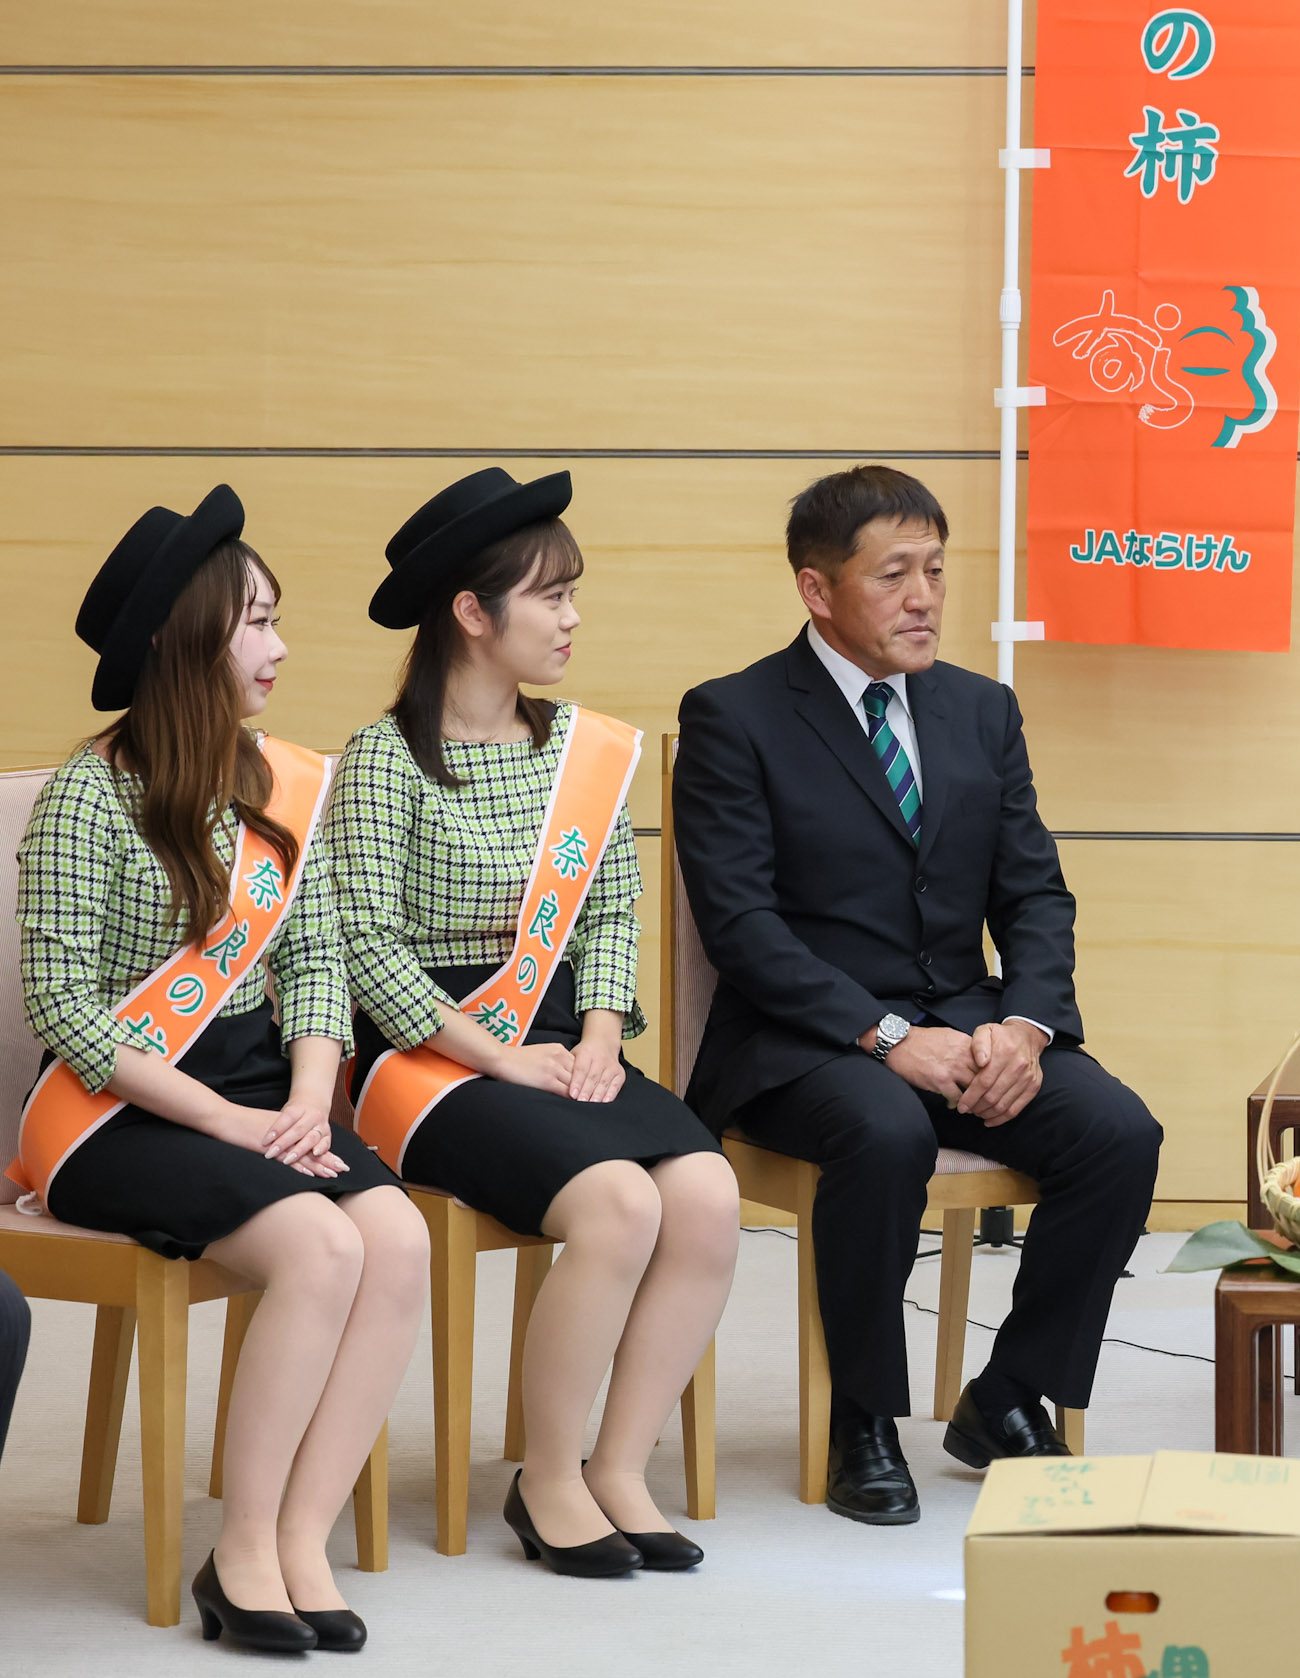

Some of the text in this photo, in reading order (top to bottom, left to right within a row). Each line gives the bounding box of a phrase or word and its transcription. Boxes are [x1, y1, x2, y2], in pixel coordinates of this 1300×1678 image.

[1123, 8, 1219, 205] の柿
[1070, 530, 1251, 573] JAならけん
